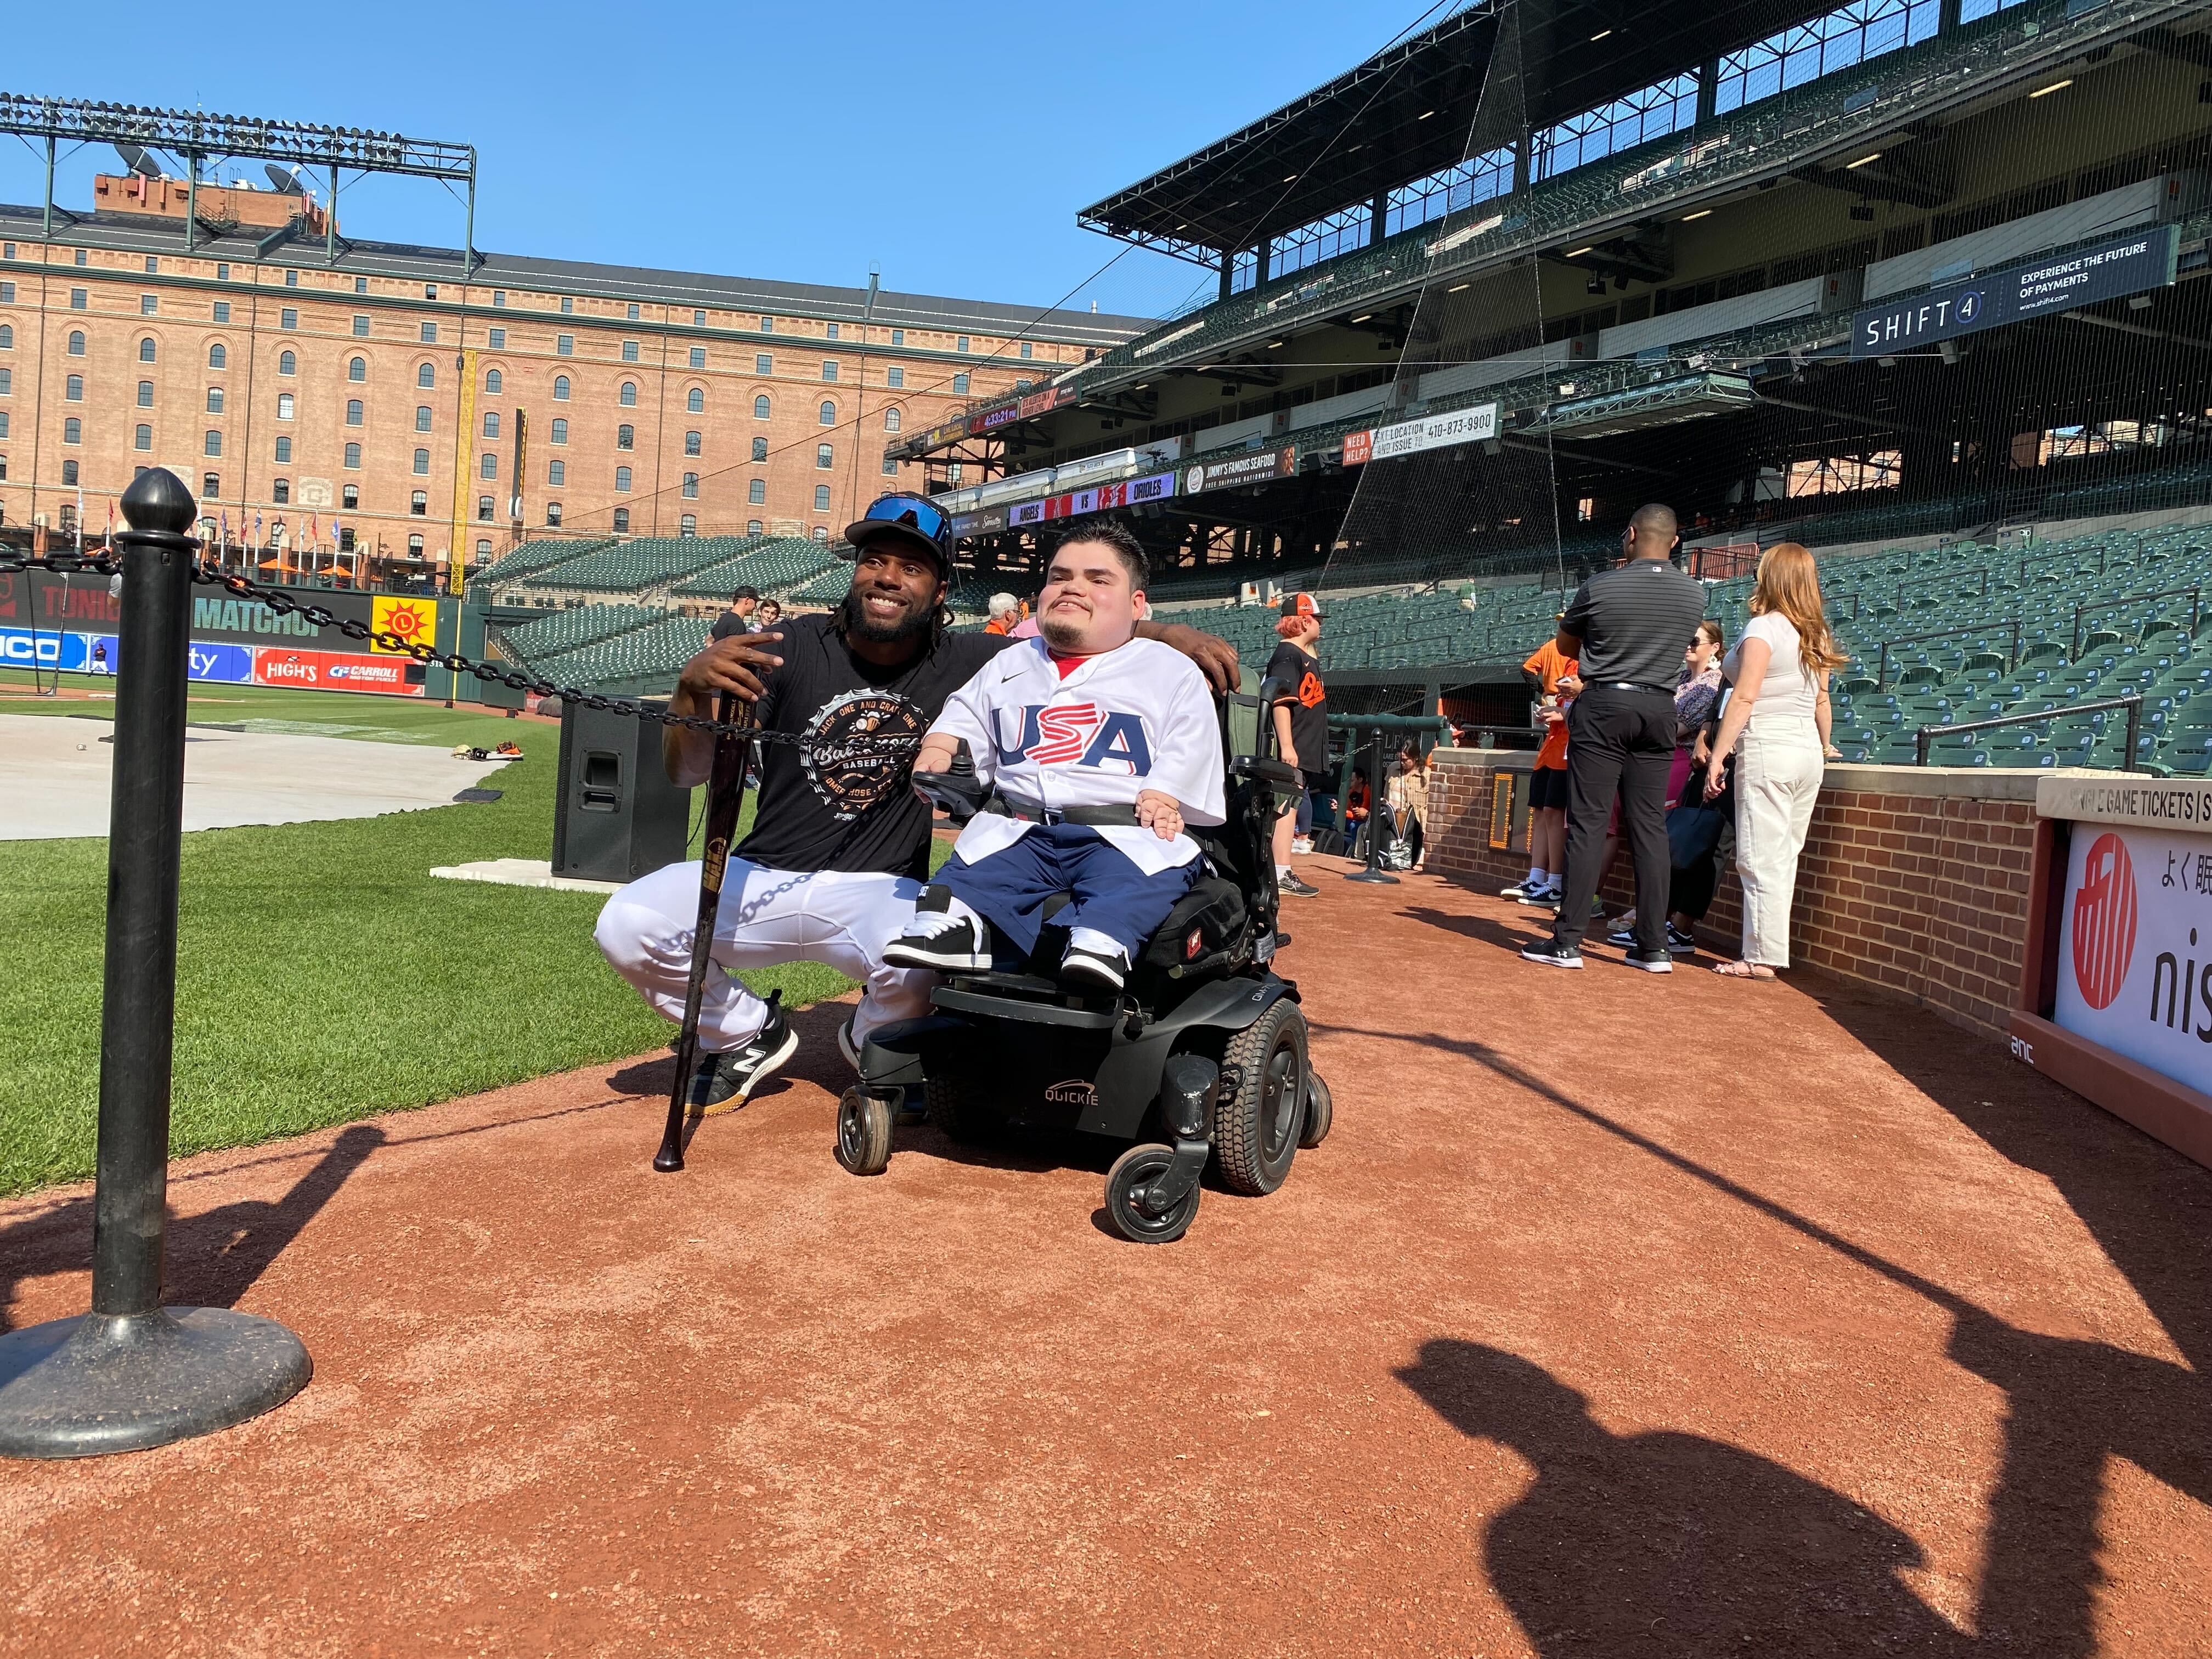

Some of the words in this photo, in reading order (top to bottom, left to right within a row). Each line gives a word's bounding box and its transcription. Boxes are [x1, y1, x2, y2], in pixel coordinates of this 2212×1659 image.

[2021, 259, 2081, 284] EXPERIENCE
[2084, 253, 2104, 268] THE
[2105, 241, 2147, 262] FUTURE
[2019, 286, 2034, 298] OF
[2035, 272, 2089, 295] PAYMENTS
[2019, 293, 2069, 311] www.shift4.com
[1866, 300, 1951, 345] SHIFT
[985, 410, 1009, 427] 4:33:21
[1009, 409, 1016, 419] PM
[1373, 430, 1389, 442] TEXT
[1390, 422, 1424, 438] LOCATION
[1428, 414, 1491, 438] 410-873-9900
[1347, 435, 1365, 448] NEED
[1377, 444, 1390, 455] AND
[1392, 440, 1412, 453] ISSUE
[1415, 437, 1423, 447] TO
[1206, 463, 1228, 478] JIMMY'S
[1228, 458, 1250, 475] FAMOUS
[1250, 453, 1276, 471] SEAFOOD
[1346, 448, 1368, 462] HELP?
[1133, 478, 1161, 500] ORIOLES
[1218, 477, 1241, 487] SHIPPING
[1243, 471, 1274, 482] NATIONWIDE
[1081, 494, 1088, 509] VS
[1019, 505, 1039, 522] ANGELS
[267, 662, 317, 688] HIGH'S
[350, 665, 399, 678] CARROLL
[818, 714, 837, 736] JACK
[838, 703, 856, 717] ONE
[860, 701, 876, 709] AND
[902, 713, 918, 730] ONE
[991, 701, 1152, 777] USA
[843, 756, 895, 770] BASEBALL
[823, 775, 846, 795] HOMER
[848, 788, 872, 797] HOSE
[2107, 789, 2138, 815] GAME
[2141, 790, 2193, 820] TICKETS
[2011, 1035, 2034, 1064] anc
[1045, 1090, 1098, 1106] QUICKIE
